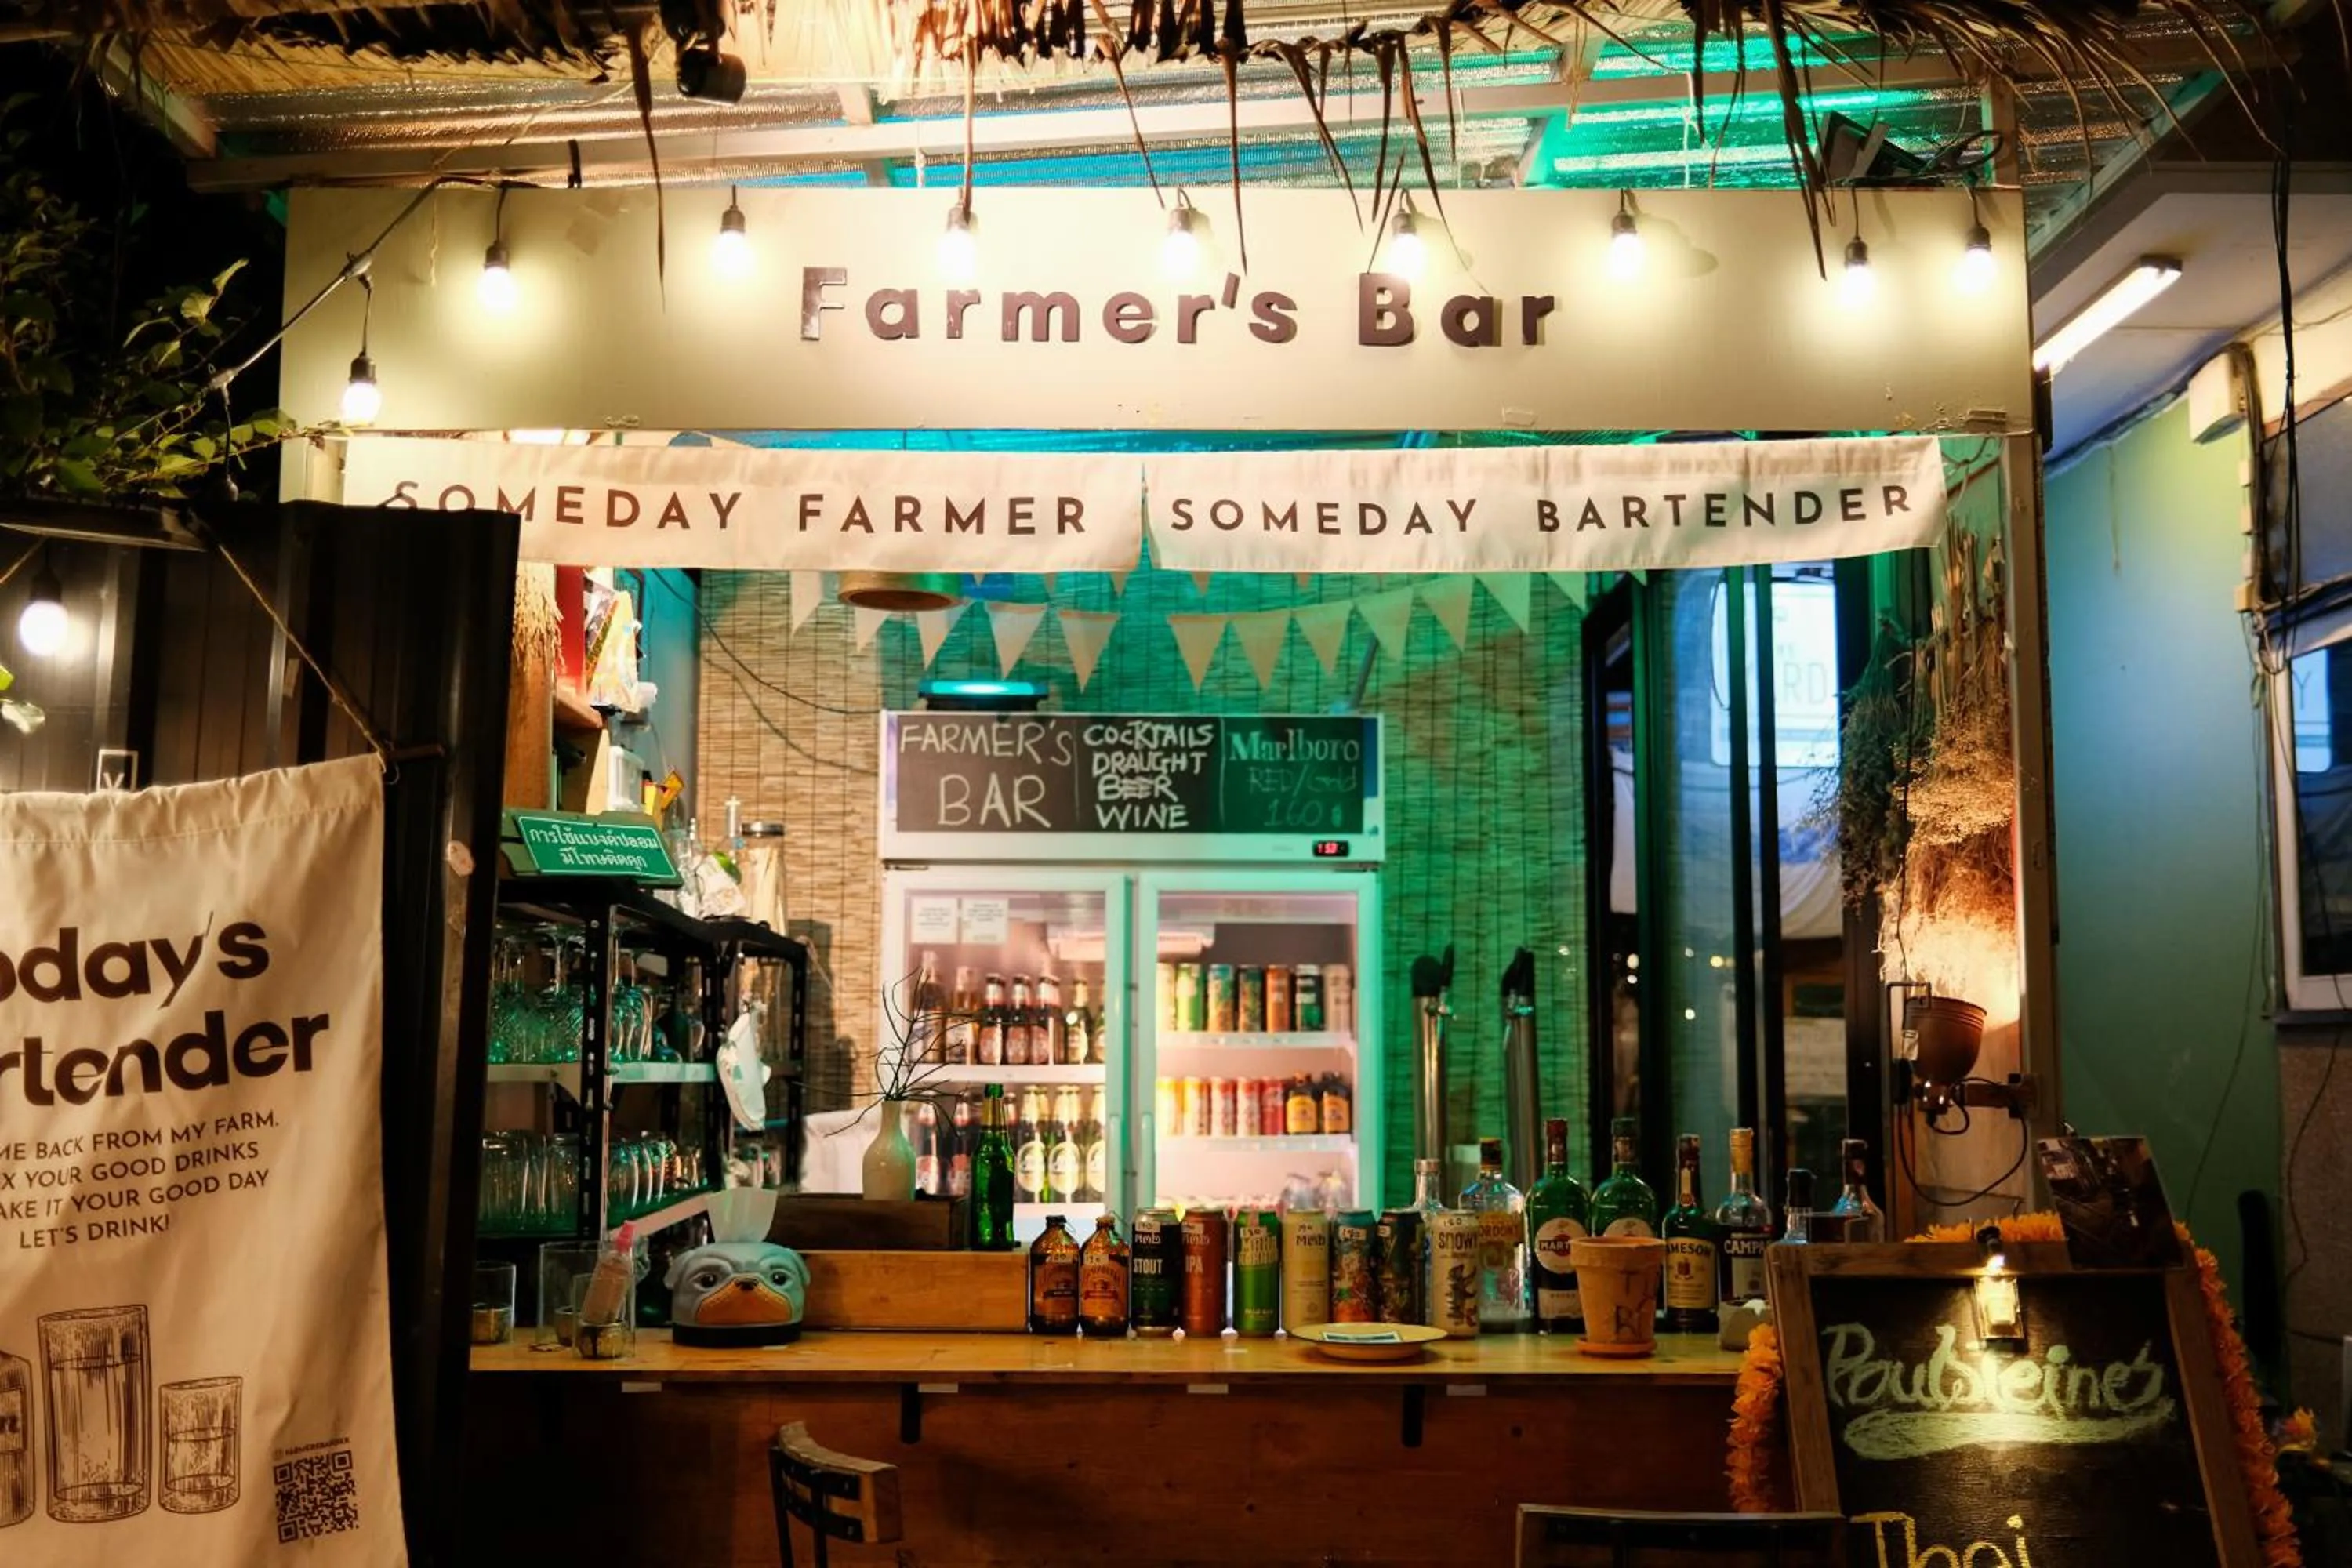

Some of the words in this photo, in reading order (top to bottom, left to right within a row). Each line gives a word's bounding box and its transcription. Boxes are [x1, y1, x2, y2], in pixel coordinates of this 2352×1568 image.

[800, 267, 1298, 343] Farmer's
[1359, 272, 1555, 347] Bar
[394, 481, 741, 530] SOMEDAY
[798, 494, 1085, 535] FARMER
[1171, 499, 1476, 535] SOMEDAY
[1537, 485, 1911, 532] BARTENDER
[900, 720, 1073, 766] FARMER'S
[1083, 720, 1214, 750] COCKTAILS
[1228, 728, 1360, 762] Marlboro
[1092, 750, 1208, 778] DRAUGHT
[938, 772, 1051, 829] BAR
[1098, 773, 1179, 803] BEER
[1095, 804, 1189, 831] WINE
[0, 911, 270, 1010] day's
[36, 1136, 84, 1160] BACK
[93, 1128, 162, 1152] FROM
[171, 1121, 206, 1144] MY
[215, 1110, 279, 1135] FARM.
[25, 1166, 82, 1189] YOUR
[92, 1157, 165, 1181] GOOD
[175, 1141, 259, 1173] DRINKS
[46, 1199, 63, 1217] IT
[71, 1189, 140, 1213] YOUR
[149, 1176, 220, 1204] GOOD
[228, 1168, 269, 1191] DAY
[20, 1225, 78, 1249] LET'S
[88, 1214, 169, 1241] DRINK!
[1133, 1258, 1163, 1274] STOUT
[1185, 1254, 1203, 1273] IPA
